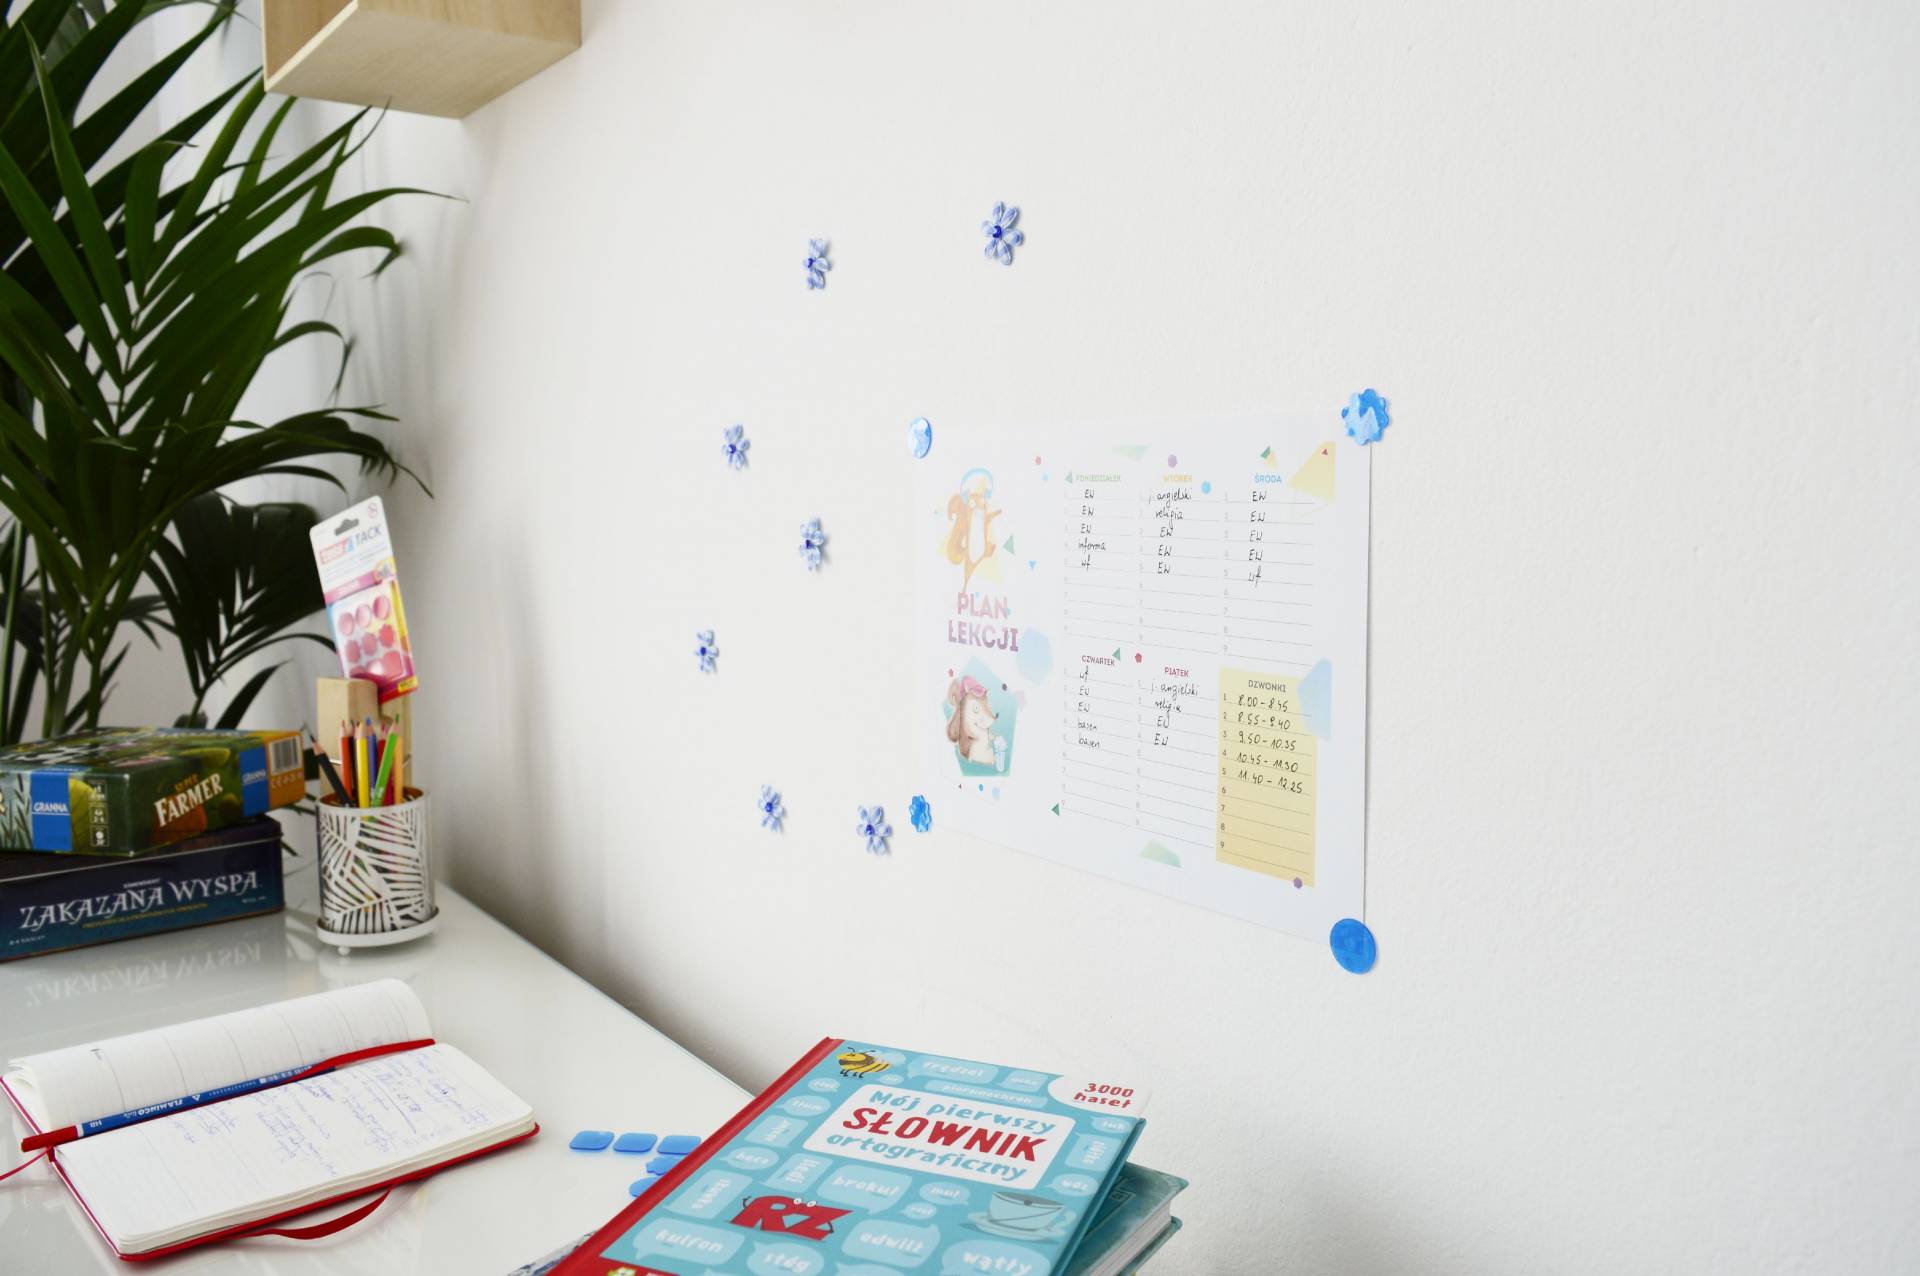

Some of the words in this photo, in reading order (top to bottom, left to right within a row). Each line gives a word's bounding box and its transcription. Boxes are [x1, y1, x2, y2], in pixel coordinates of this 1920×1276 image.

[355, 523, 382, 545] TACK
[957, 592, 1008, 620] PLAN
[1081, 655, 1115, 667] CZWARTEK
[1248, 680, 1287, 693] DZWONKI
[33, 802, 69, 813] GRANNA
[154, 773, 223, 827] FARMER
[19, 886, 165, 933] ZAKAZANA
[169, 871, 258, 901] WYSPA
[1073, 1092, 1133, 1110] haseł
[1083, 1082, 1135, 1098] 3000
[869, 1089, 918, 1111] Mój
[926, 1100, 1057, 1135] pierwszy
[841, 1106, 1049, 1163] SŁOWNIK
[826, 1133, 1028, 1182] ortograficzny
[655, 1228, 724, 1254] kulfon
[763, 1250, 811, 1274] stóg
